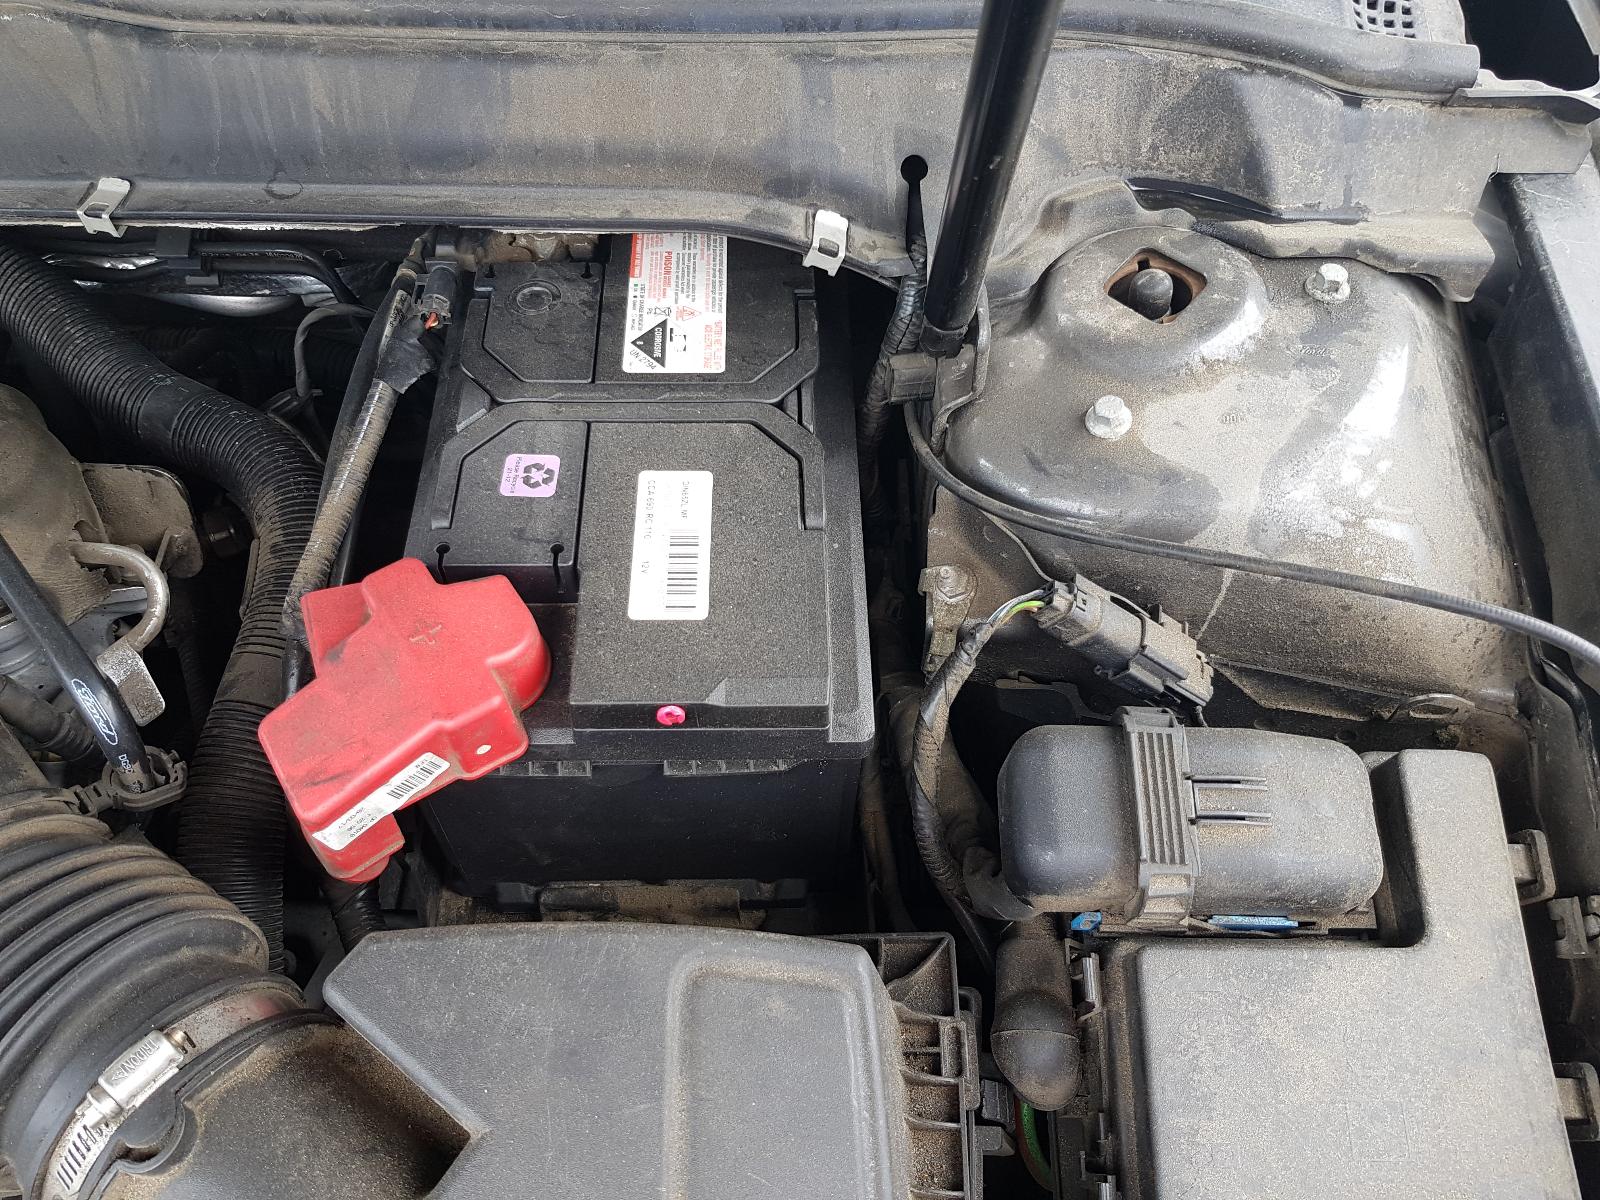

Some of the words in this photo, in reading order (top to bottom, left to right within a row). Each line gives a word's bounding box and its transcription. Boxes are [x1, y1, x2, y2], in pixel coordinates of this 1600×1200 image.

[663, 251, 673, 276] POISON
[653, 327, 663, 358] CORROSIVE
[647, 480, 656, 495] CCA
[645, 513, 654, 524] RC
[641, 560, 650, 575] 12V
[76, 685, 116, 737] Ford
[120, 1038, 160, 1075] TRIDON
